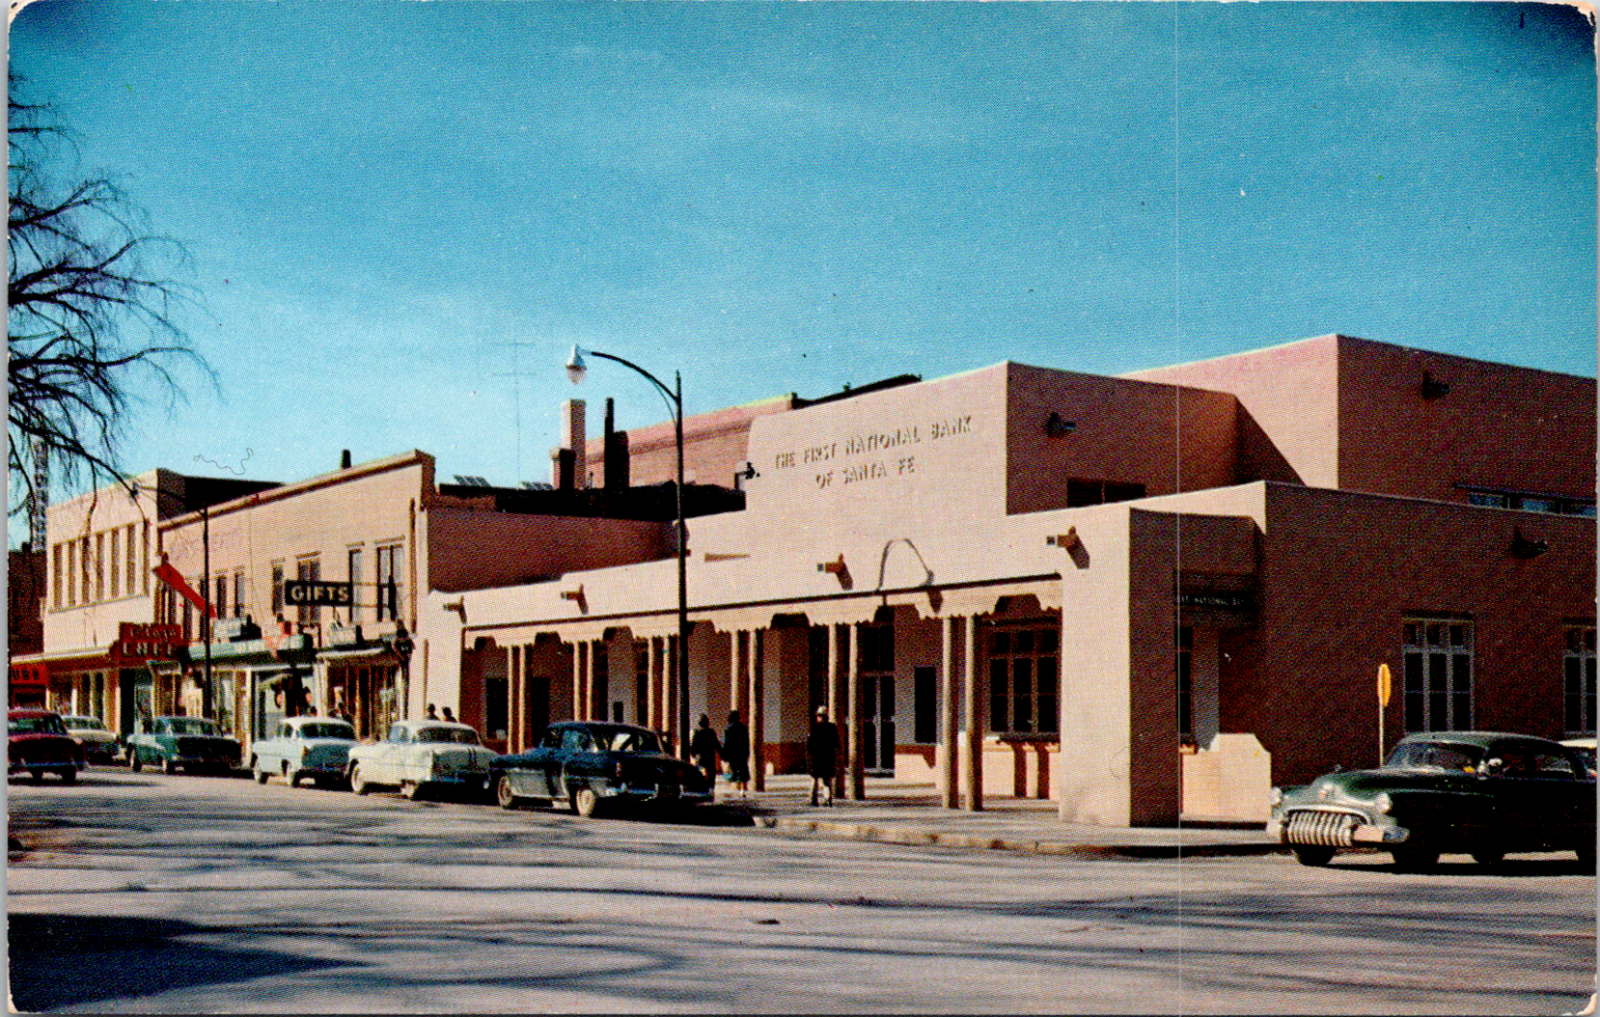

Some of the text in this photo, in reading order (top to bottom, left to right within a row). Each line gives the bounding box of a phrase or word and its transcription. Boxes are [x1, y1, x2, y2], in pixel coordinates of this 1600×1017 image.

[775, 415, 972, 469] THE FIRST NATIONAL BANK
[815, 455, 916, 488] OF SANTA FE
[290, 585, 350, 602] GIFTS
